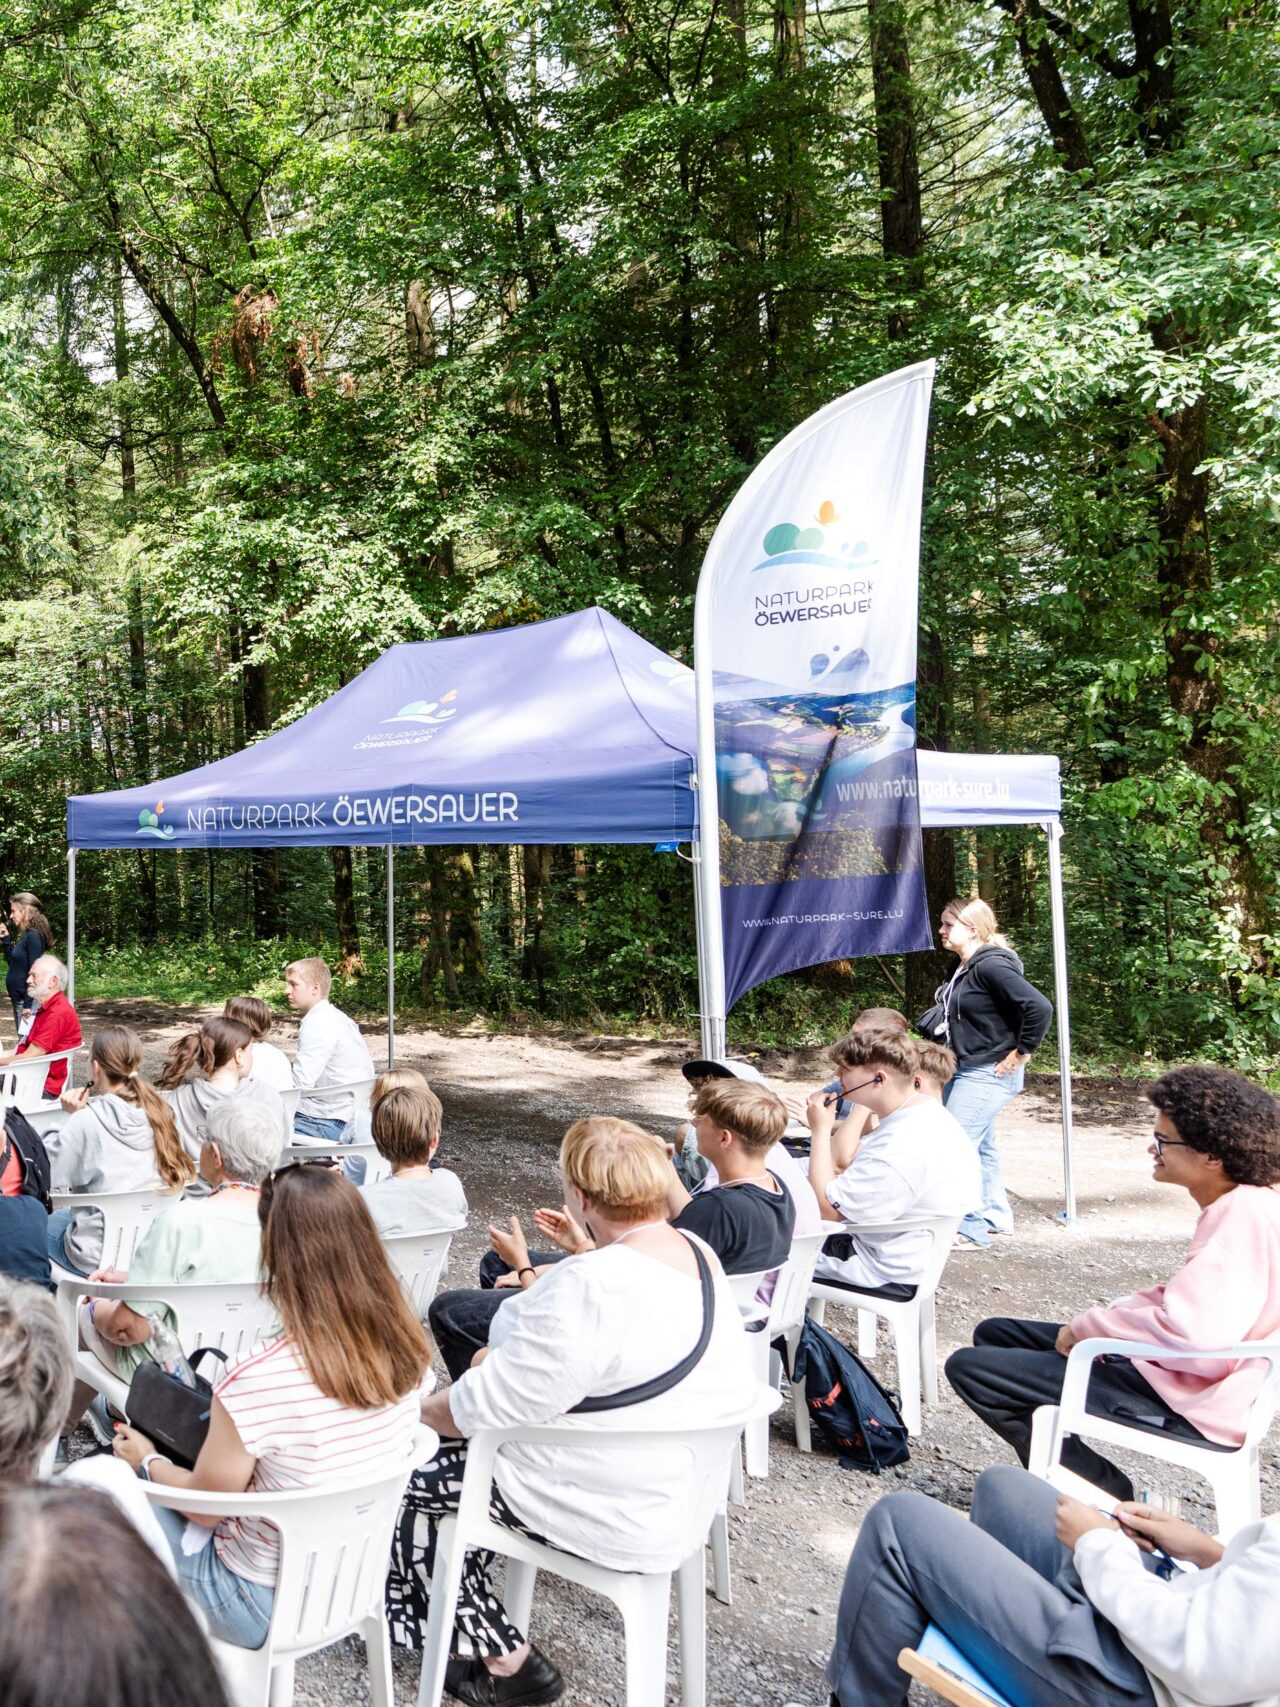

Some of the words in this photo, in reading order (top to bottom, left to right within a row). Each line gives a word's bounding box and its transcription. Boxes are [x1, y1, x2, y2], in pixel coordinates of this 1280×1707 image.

[755, 580, 875, 609] NATURPARK
[835, 775, 1011, 802] www.naturpark-sure.lu
[187, 801, 327, 831] NATURPARK
[332, 792, 519, 827] ÖEWERSAUER
